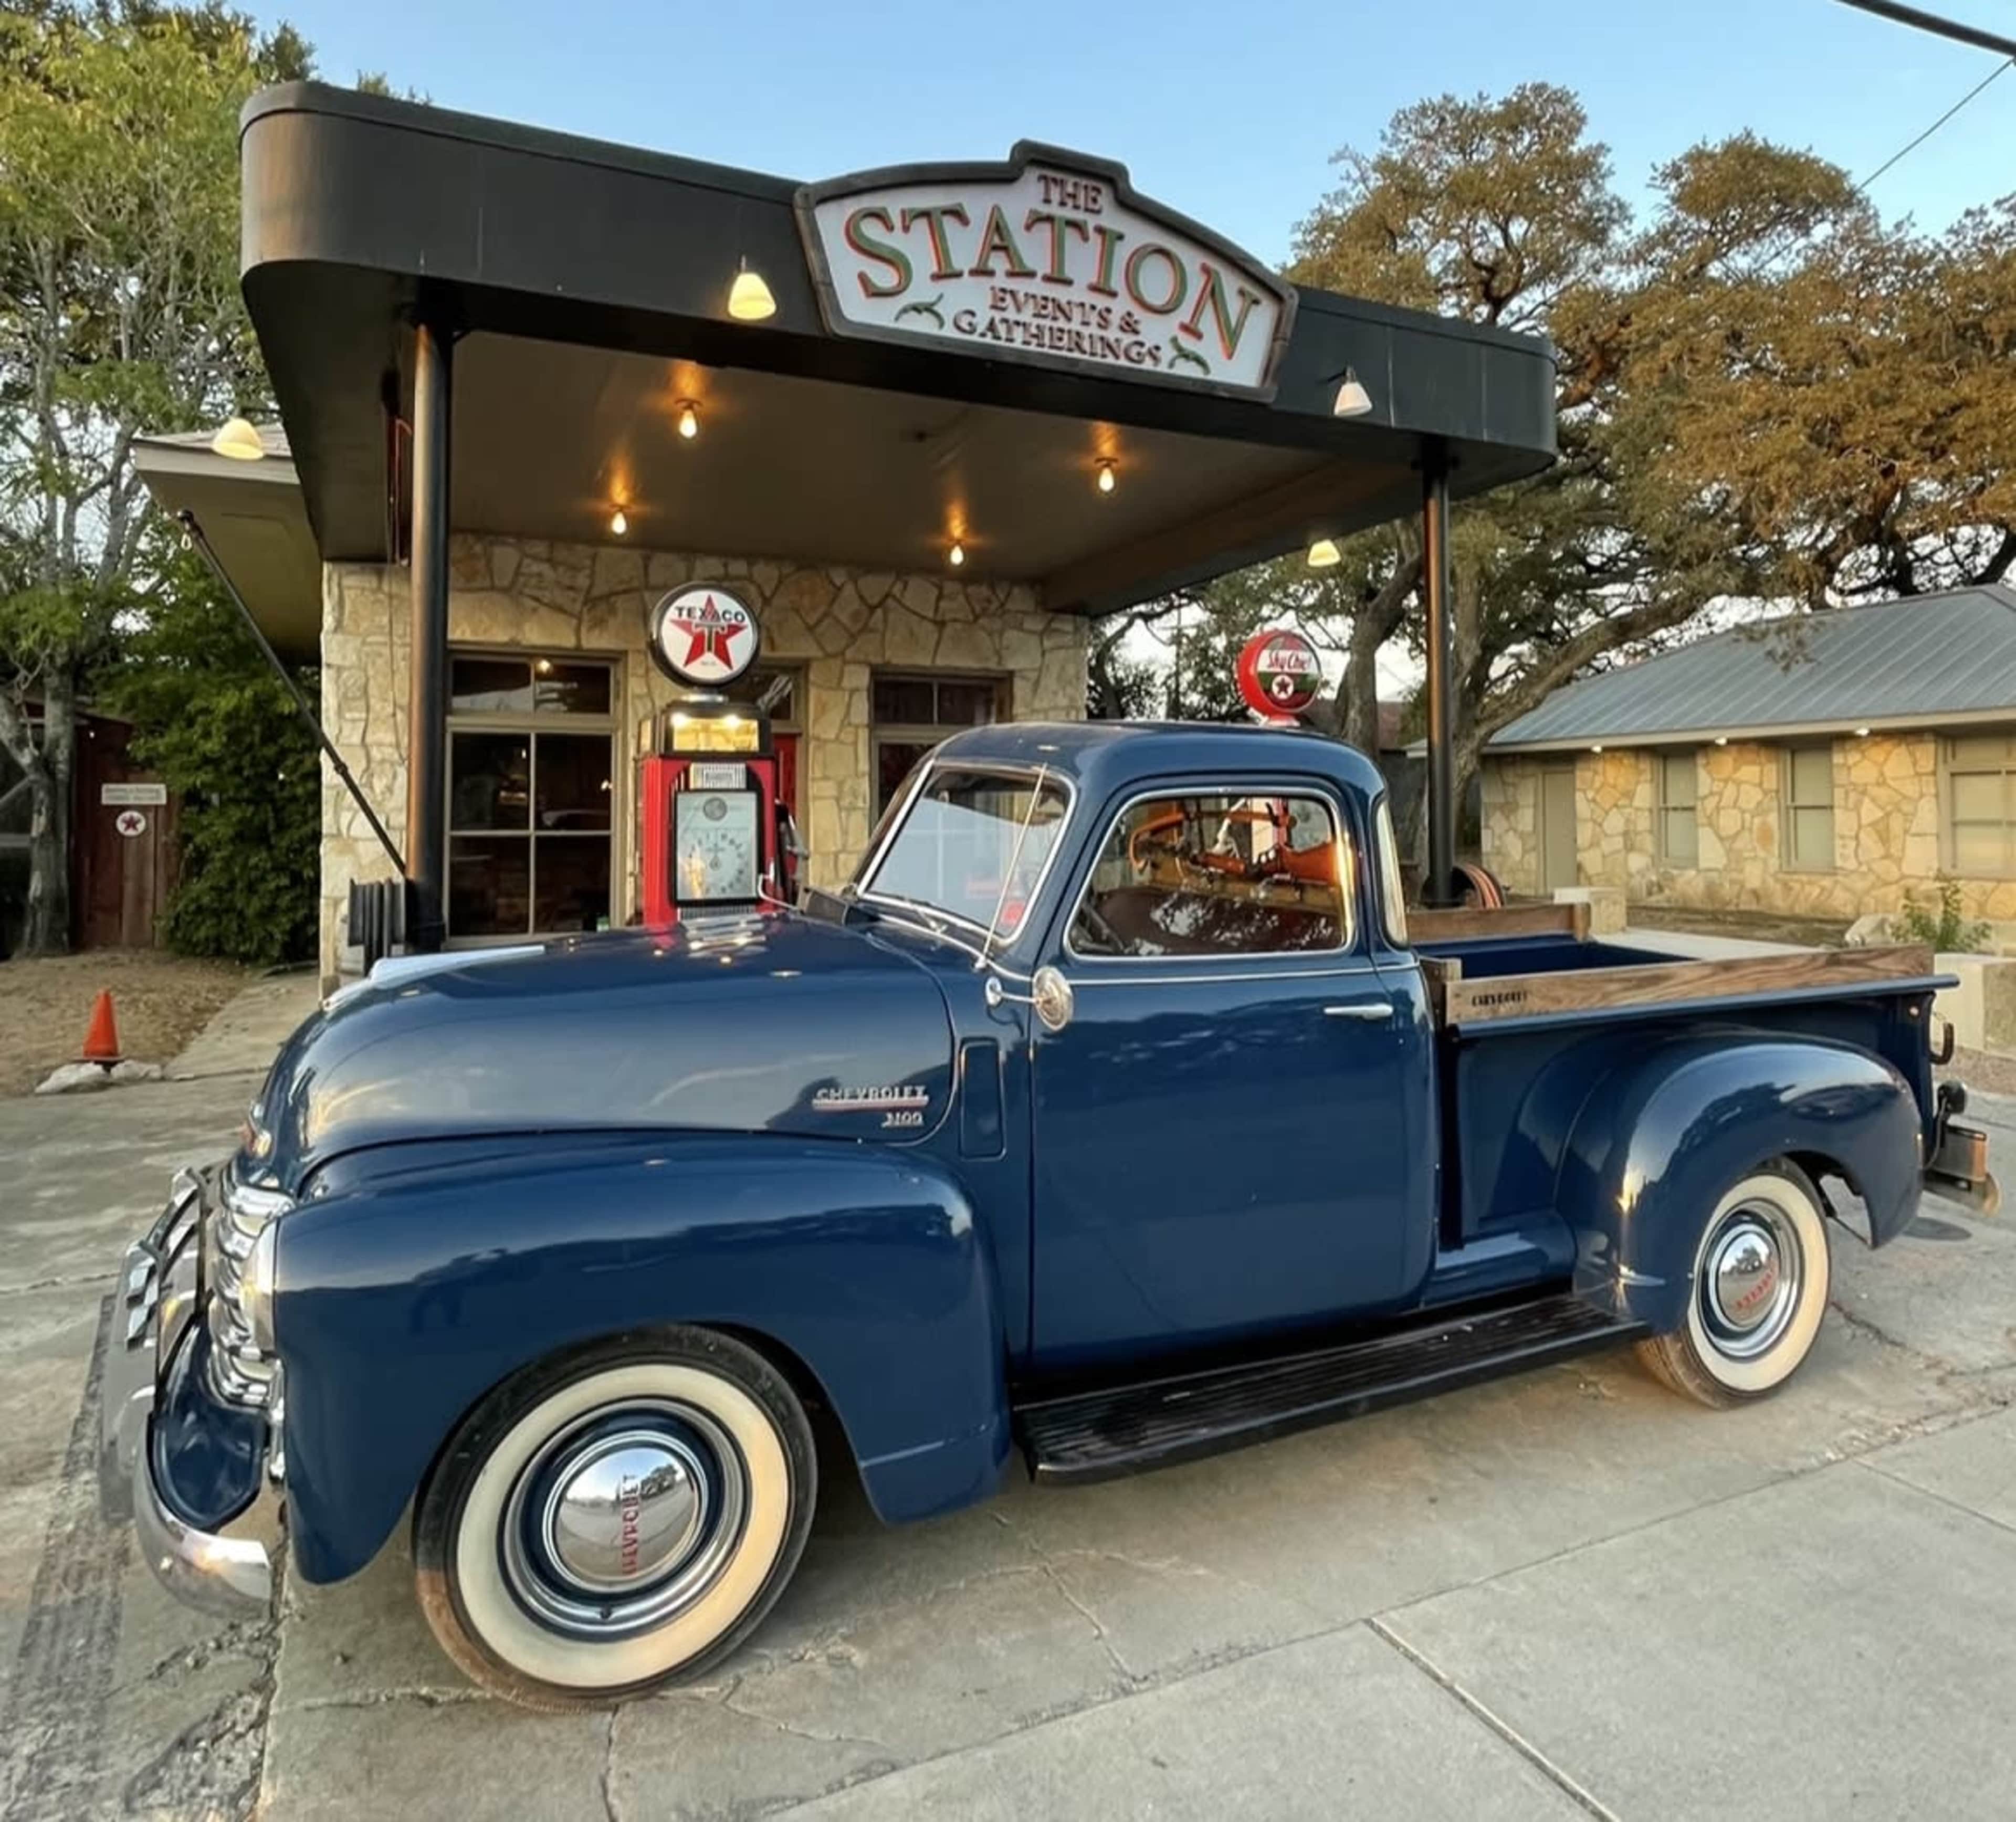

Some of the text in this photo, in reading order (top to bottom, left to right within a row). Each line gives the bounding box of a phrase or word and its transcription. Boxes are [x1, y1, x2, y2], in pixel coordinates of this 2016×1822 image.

[1037, 174, 1103, 213] THE
[844, 203, 1261, 361] STATION
[990, 286, 1141, 335] EVENTS &
[953, 309, 1162, 366] GATHERINGS
[674, 605, 746, 623] TEXACO
[816, 1085, 927, 1101] CHEVROLET
